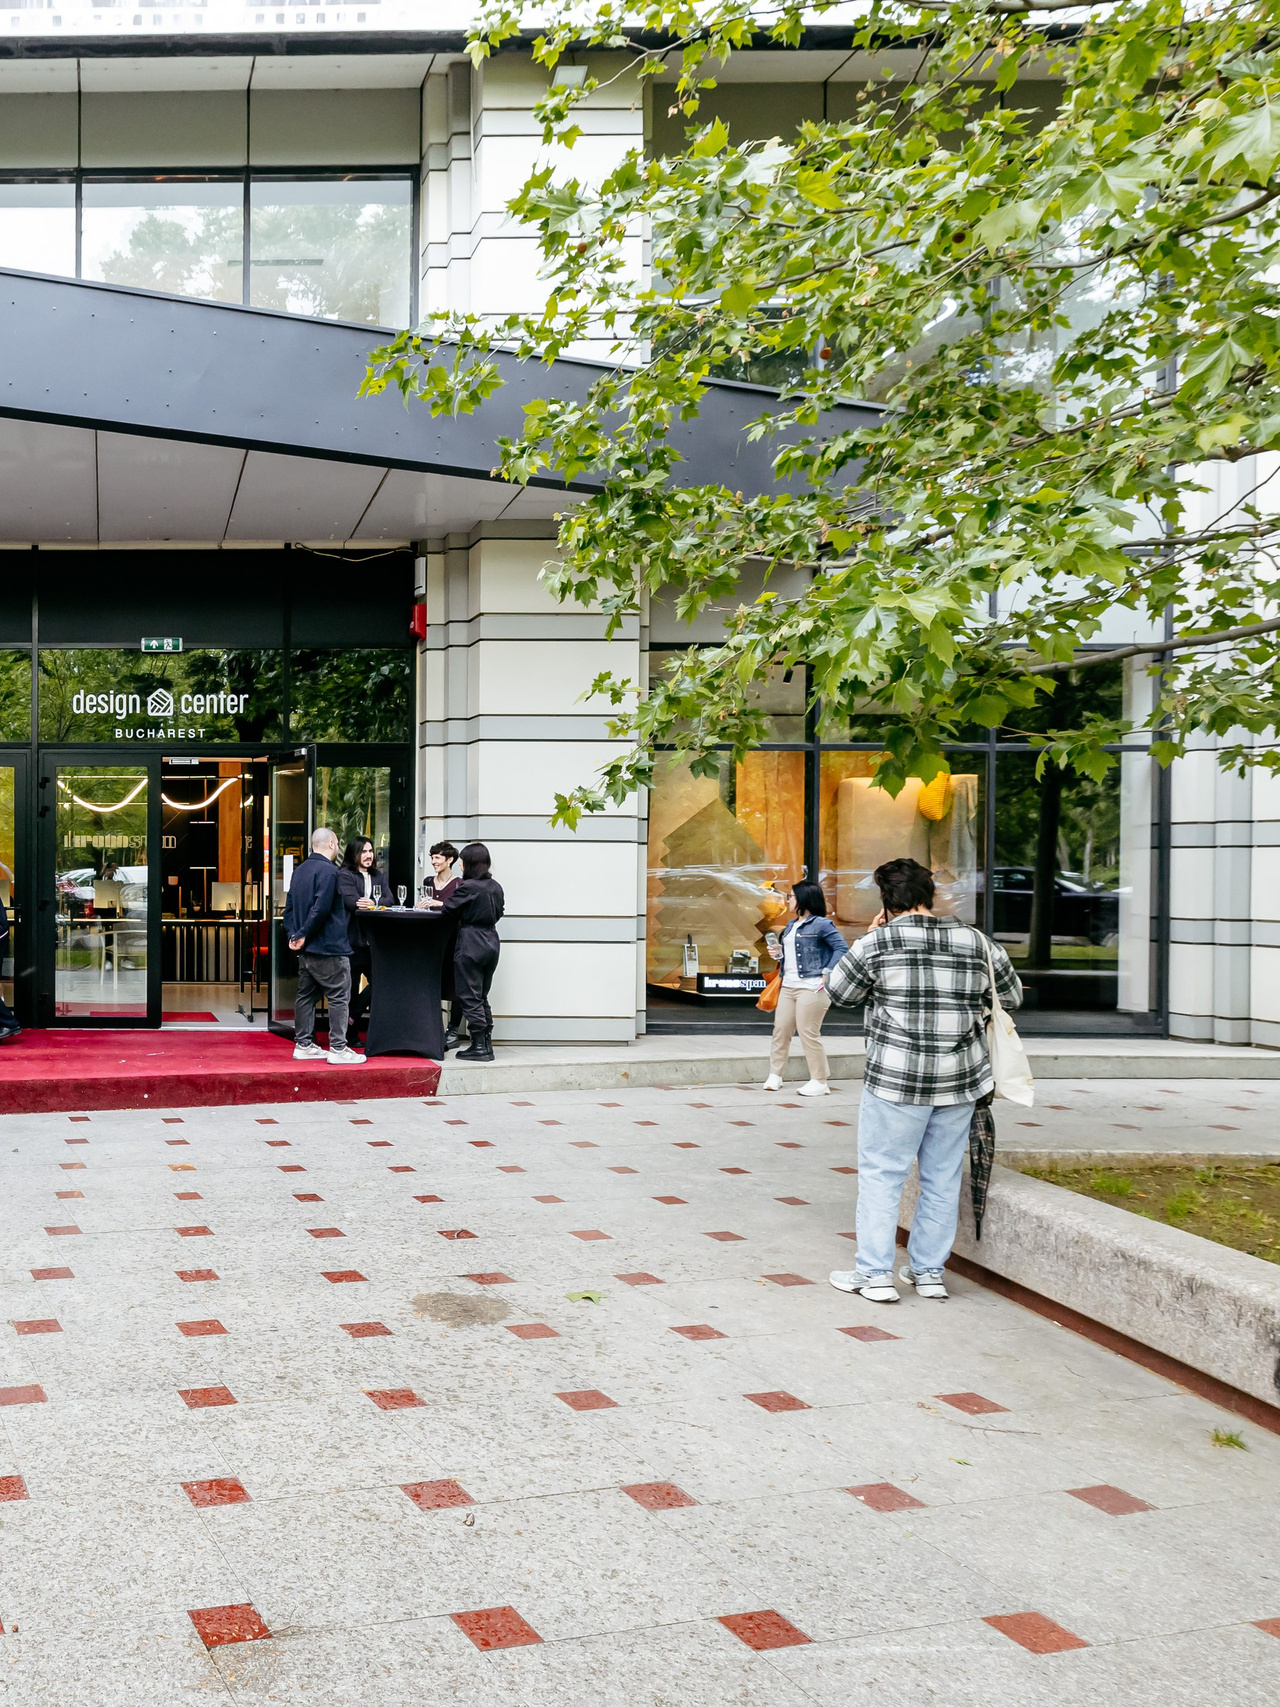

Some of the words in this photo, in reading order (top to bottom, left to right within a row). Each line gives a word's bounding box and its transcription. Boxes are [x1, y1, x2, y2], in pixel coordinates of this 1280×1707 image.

[72, 689, 141, 720] design
[180, 690, 250, 714] center
[115, 728, 206, 739] BUCHAREST
[703, 976, 767, 991] kronospan
